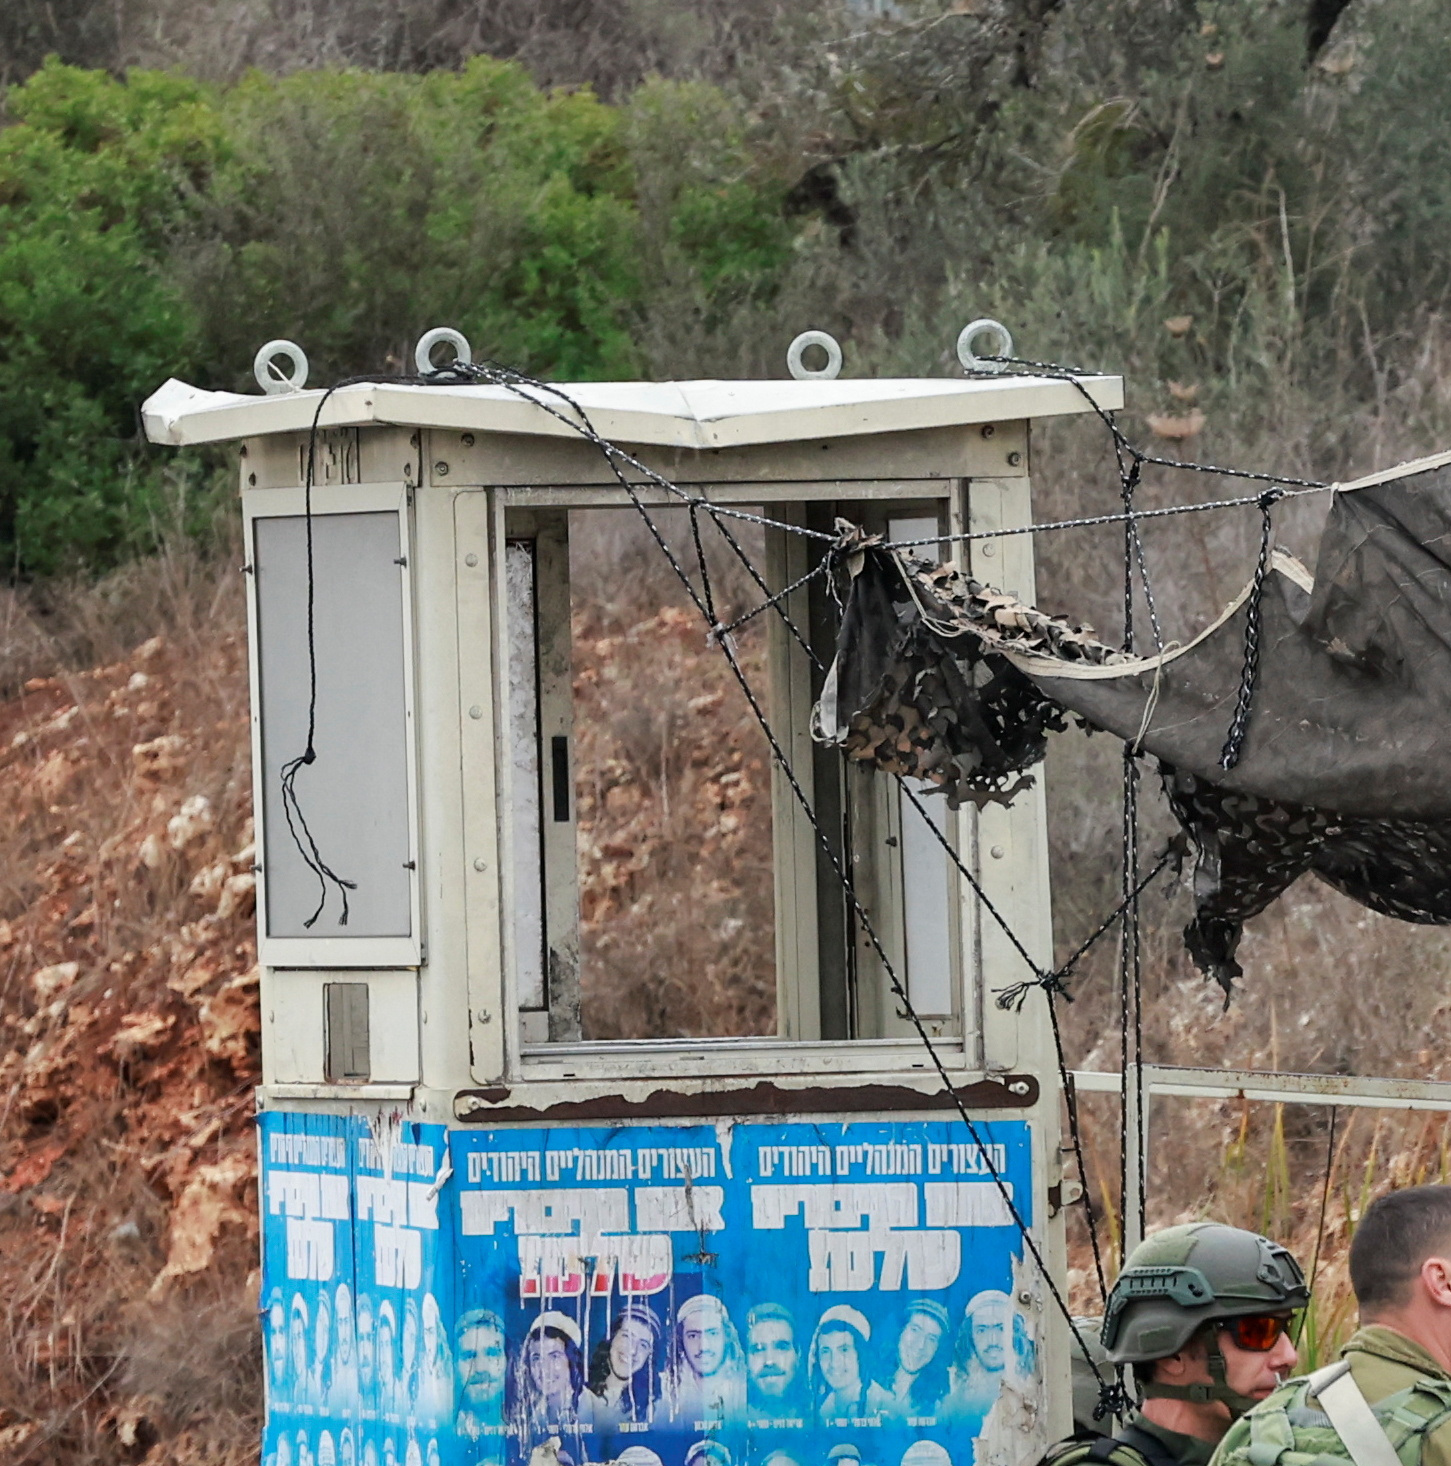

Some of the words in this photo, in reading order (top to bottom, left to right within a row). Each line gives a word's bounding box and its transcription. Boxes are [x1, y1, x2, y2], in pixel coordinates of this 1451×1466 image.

[468, 1151, 540, 1183] היהודים
[546, 1148, 632, 1181] המנהליים
[638, 1148, 715, 1179] העצורים
[759, 1146, 831, 1176] היהודים
[836, 1143, 922, 1175] המנהליים
[928, 1143, 1005, 1174] העצורים
